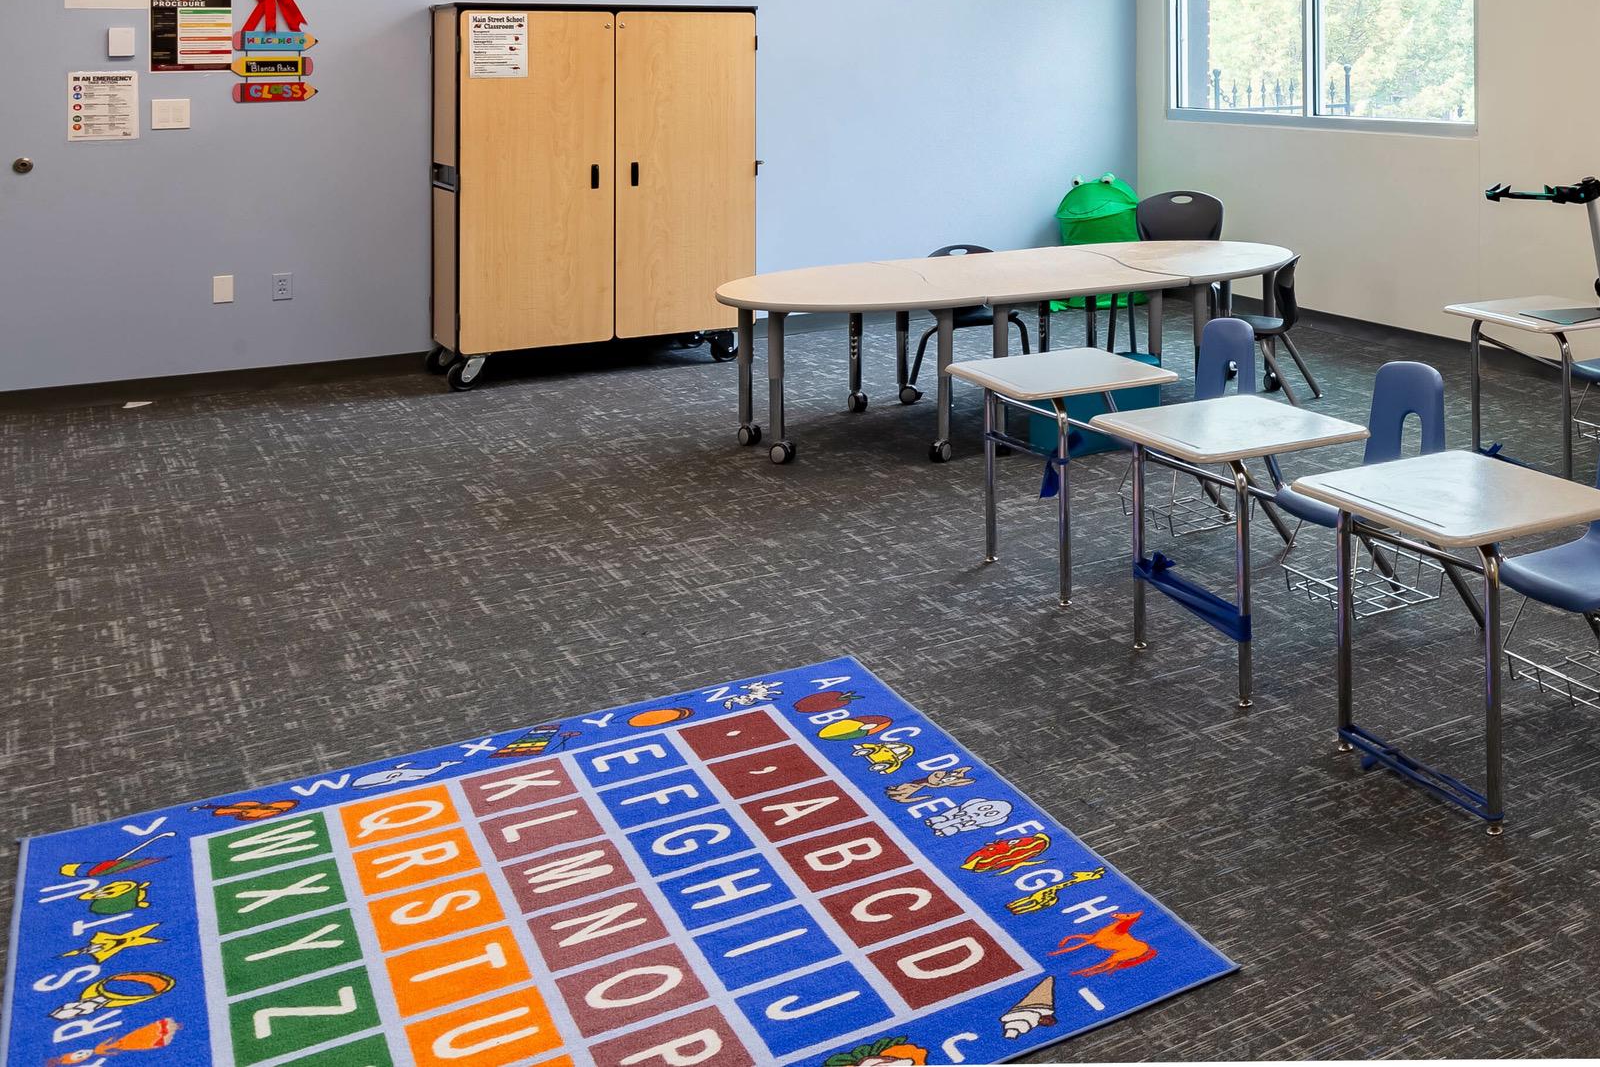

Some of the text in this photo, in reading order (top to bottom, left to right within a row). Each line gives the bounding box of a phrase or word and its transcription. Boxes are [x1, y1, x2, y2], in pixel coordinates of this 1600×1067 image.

[229, 820, 356, 1038] W X Y Z
[358, 801, 537, 1058] Q R S T U
[480, 770, 722, 1066] K L M N O P
[592, 745, 857, 1019] E F G H I J
[762, 797, 839, 825] A
[804, 838, 882, 871] B
[851, 888, 931, 922] C
[897, 937, 984, 979] D
